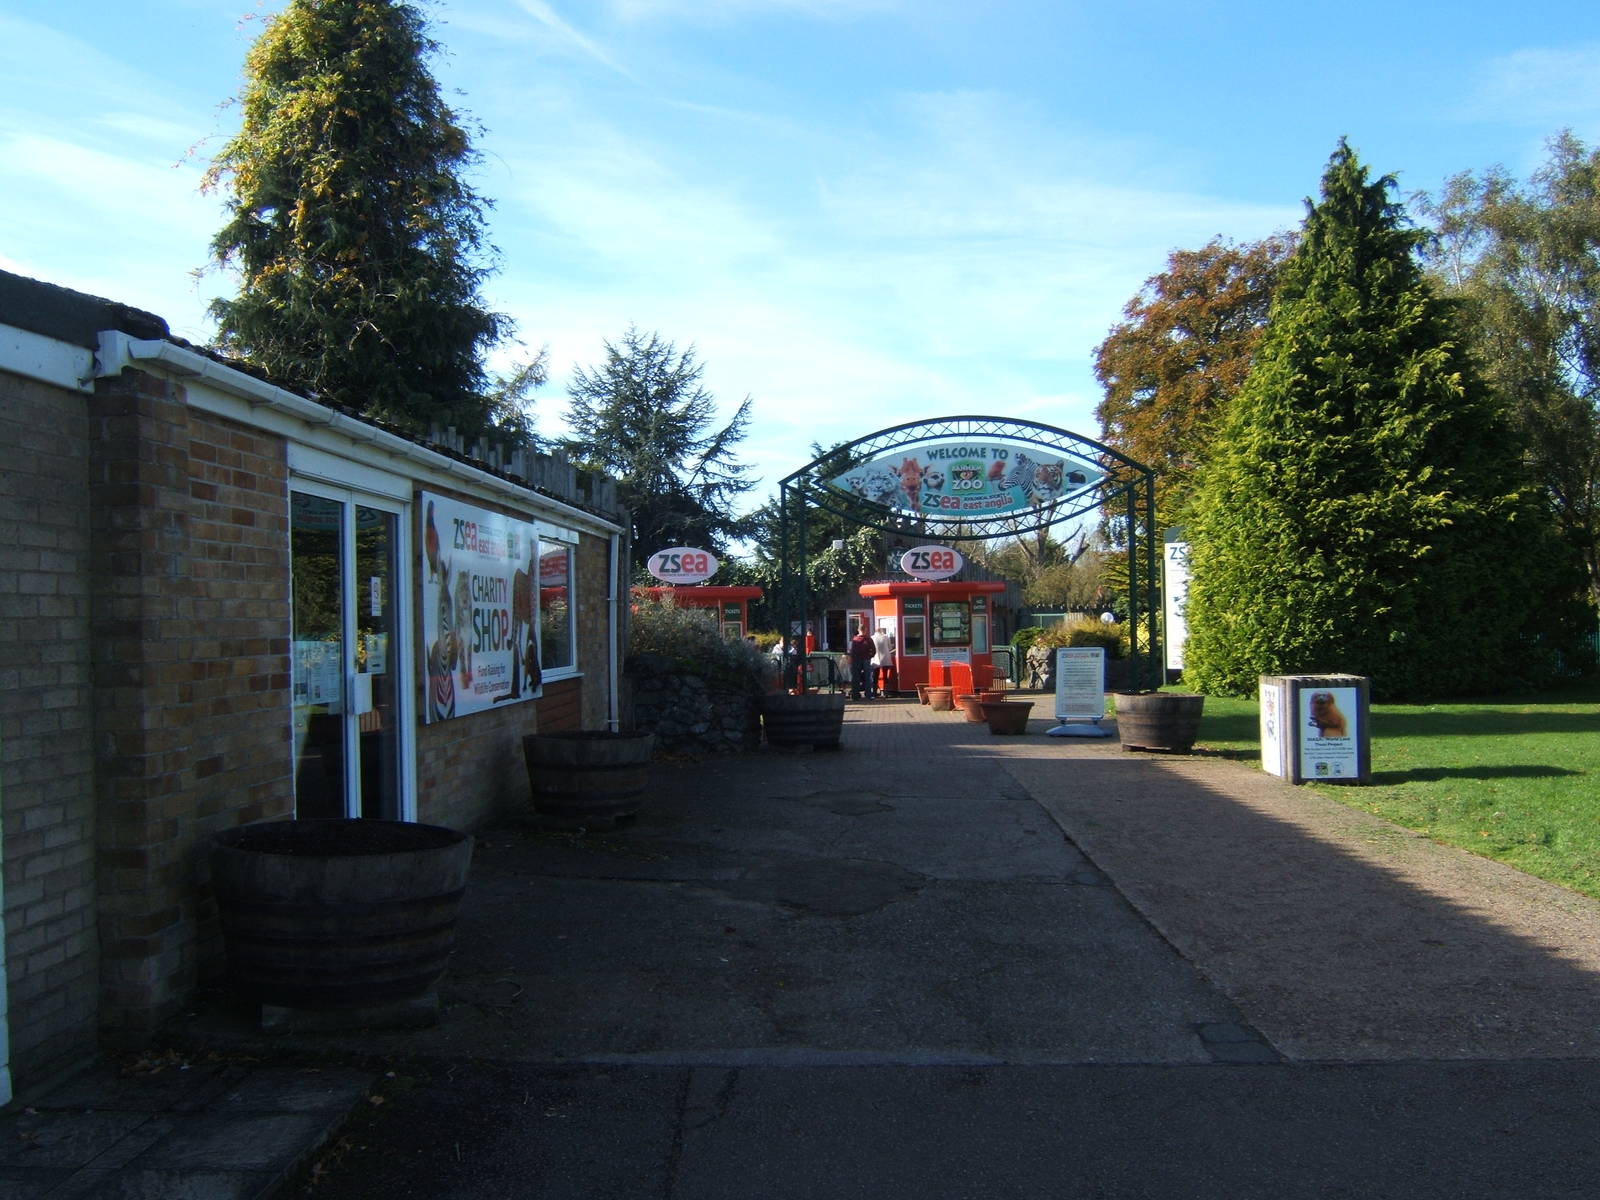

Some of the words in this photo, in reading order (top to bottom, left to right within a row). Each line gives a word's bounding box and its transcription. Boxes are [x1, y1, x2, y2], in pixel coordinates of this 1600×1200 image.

[926, 447, 987, 461] WELCOME
[991, 448, 1009, 460] TO
[951, 479, 983, 491] ZOO
[922, 493, 961, 510] zsea
[962, 501, 983, 510] east
[985, 496, 1014, 509] anglia
[658, 553, 709, 573] zsea
[910, 551, 955, 570] zsea
[472, 574, 508, 603] CHARITY
[473, 607, 509, 654] SHOP
